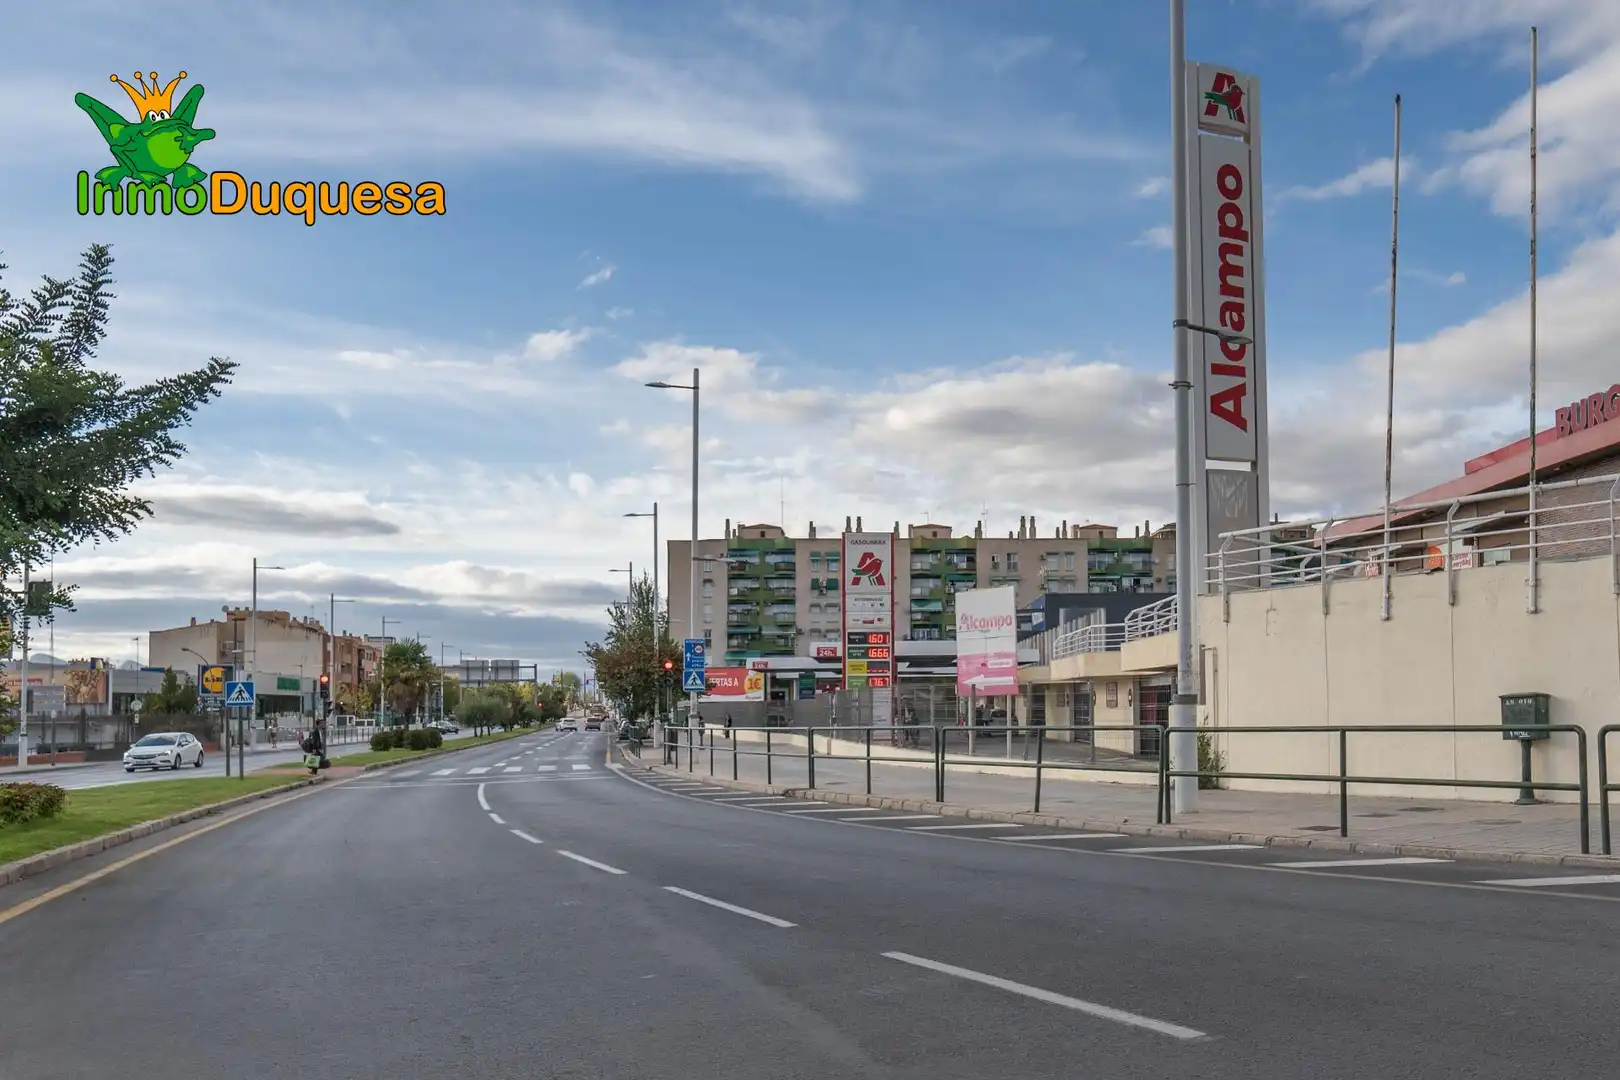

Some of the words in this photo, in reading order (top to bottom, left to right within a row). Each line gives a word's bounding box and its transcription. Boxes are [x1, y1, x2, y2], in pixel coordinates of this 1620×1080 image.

[1210, 163, 1249, 434] Alcampo
[1555, 383, 1620, 440] BURG
[959, 612, 1013, 631] Alcampo
